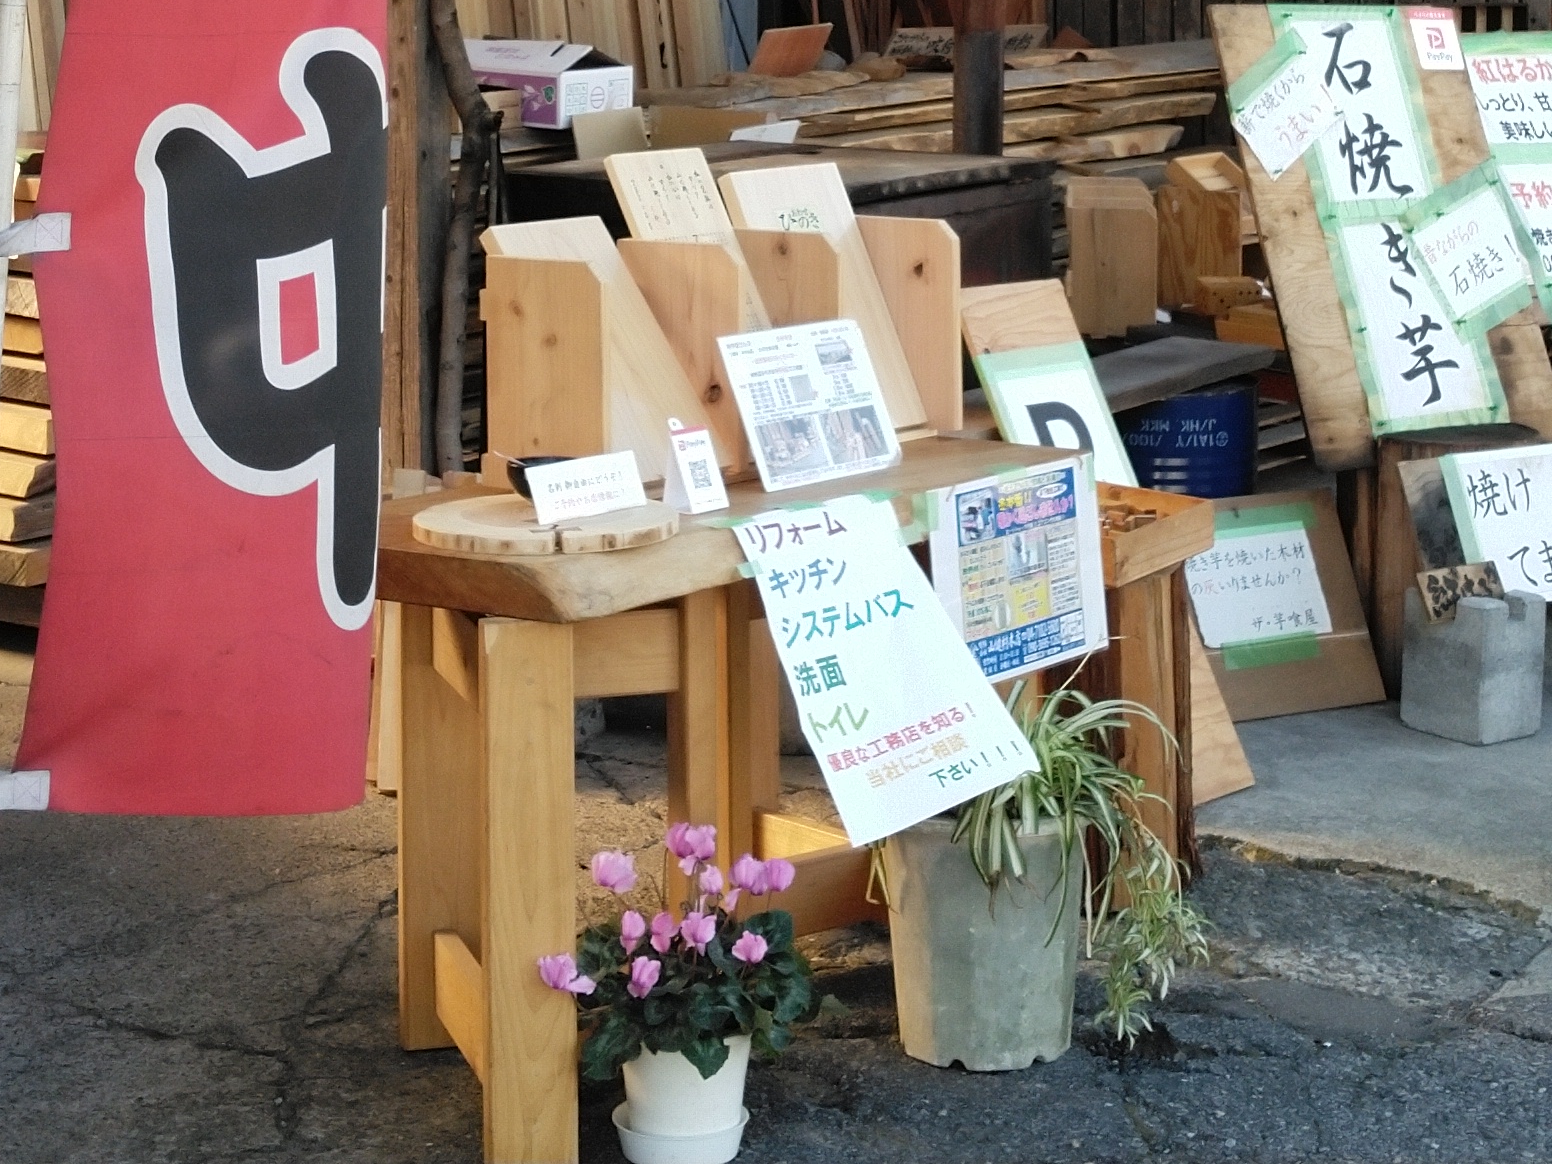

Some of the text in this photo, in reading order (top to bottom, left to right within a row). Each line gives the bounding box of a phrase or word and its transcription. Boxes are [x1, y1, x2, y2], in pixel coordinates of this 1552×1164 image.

[1324, 22, 1461, 408] 石焼き芋
[1448, 234, 1521, 297] 石焼き！
[1466, 468, 1532, 519] 焼け
[744, 510, 848, 555] リフォーム
[768, 557, 848, 600] キッチン
[779, 587, 915, 649] システムバス
[792, 654, 848, 697] 洗面
[806, 701, 870, 744] トイレ
[826, 701, 977, 774] 優良な工務店を知る！
[864, 733, 970, 789] 当社にご相談
